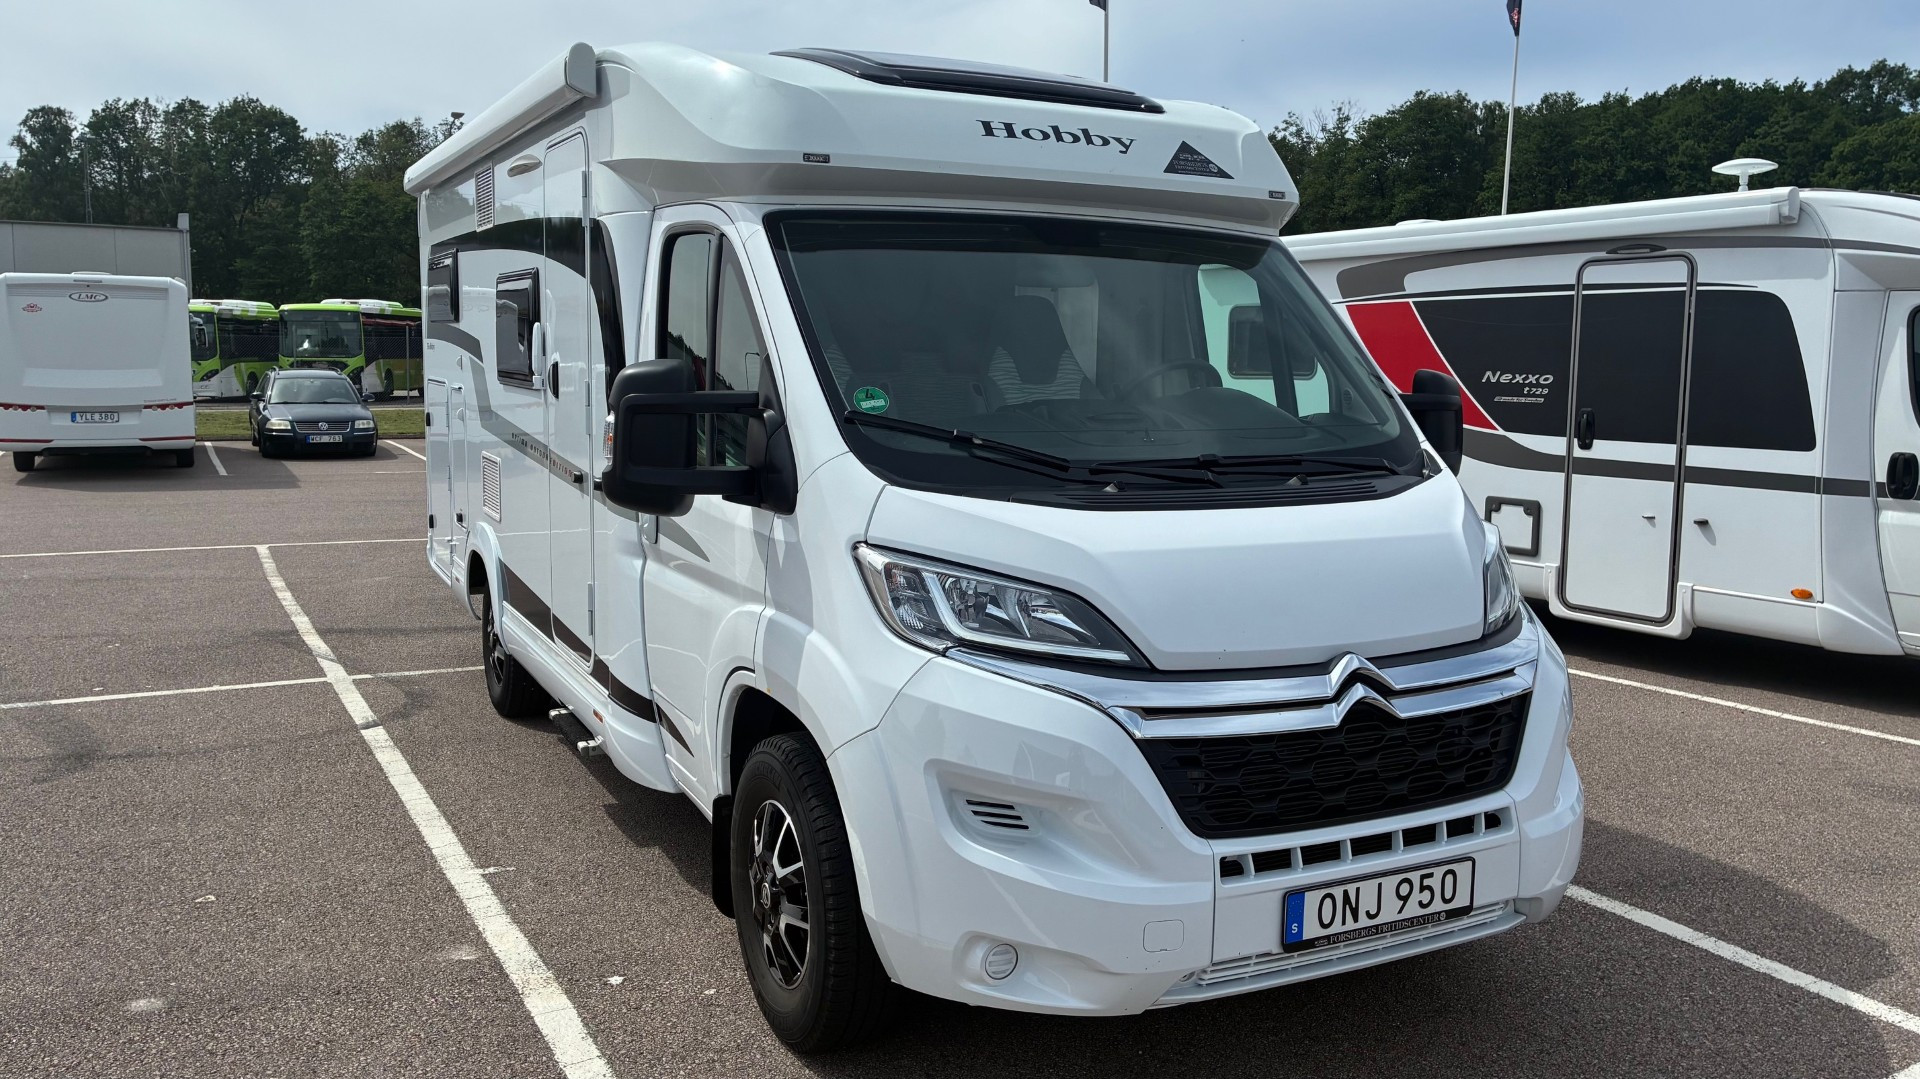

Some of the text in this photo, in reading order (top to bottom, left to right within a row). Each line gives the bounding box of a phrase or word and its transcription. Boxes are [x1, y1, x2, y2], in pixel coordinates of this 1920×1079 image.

[976, 119, 1137, 155] Hobby
[1481, 370, 1554, 385] Nexxo
[79, 413, 115, 421] YLE 380
[1291, 868, 1458, 934] S ONJ 950
[1330, 913, 1440, 944] FORSBERGS FRITIDSCENTER
